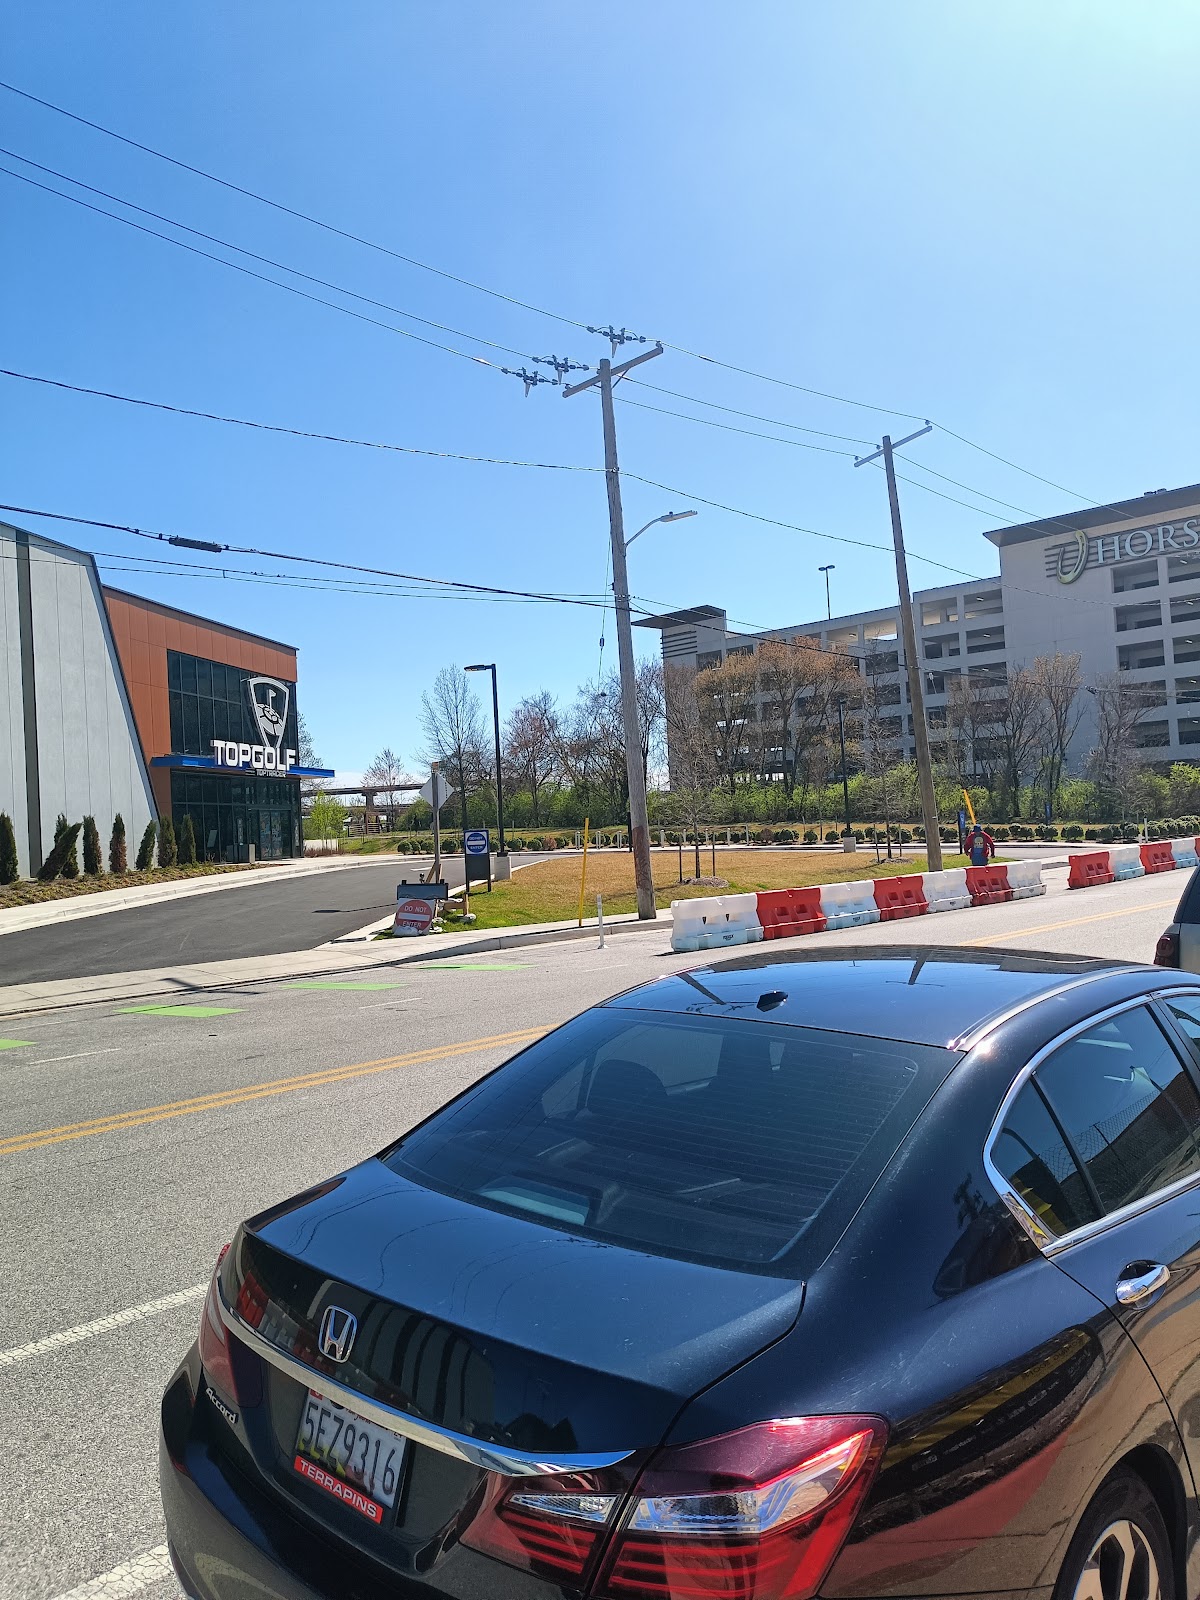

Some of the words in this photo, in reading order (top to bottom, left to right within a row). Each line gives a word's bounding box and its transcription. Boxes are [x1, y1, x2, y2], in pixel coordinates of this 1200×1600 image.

[1096, 519, 1199, 565] HORS
[212, 740, 296, 771] TOPGOLF
[256, 769, 287, 778] TOPTRACER
[402, 920, 422, 928] ENTER
[206, 1388, 236, 1424] Accord
[301, 1401, 397, 1496] 5EZ9316
[300, 1459, 377, 1518] TERRAPINS
